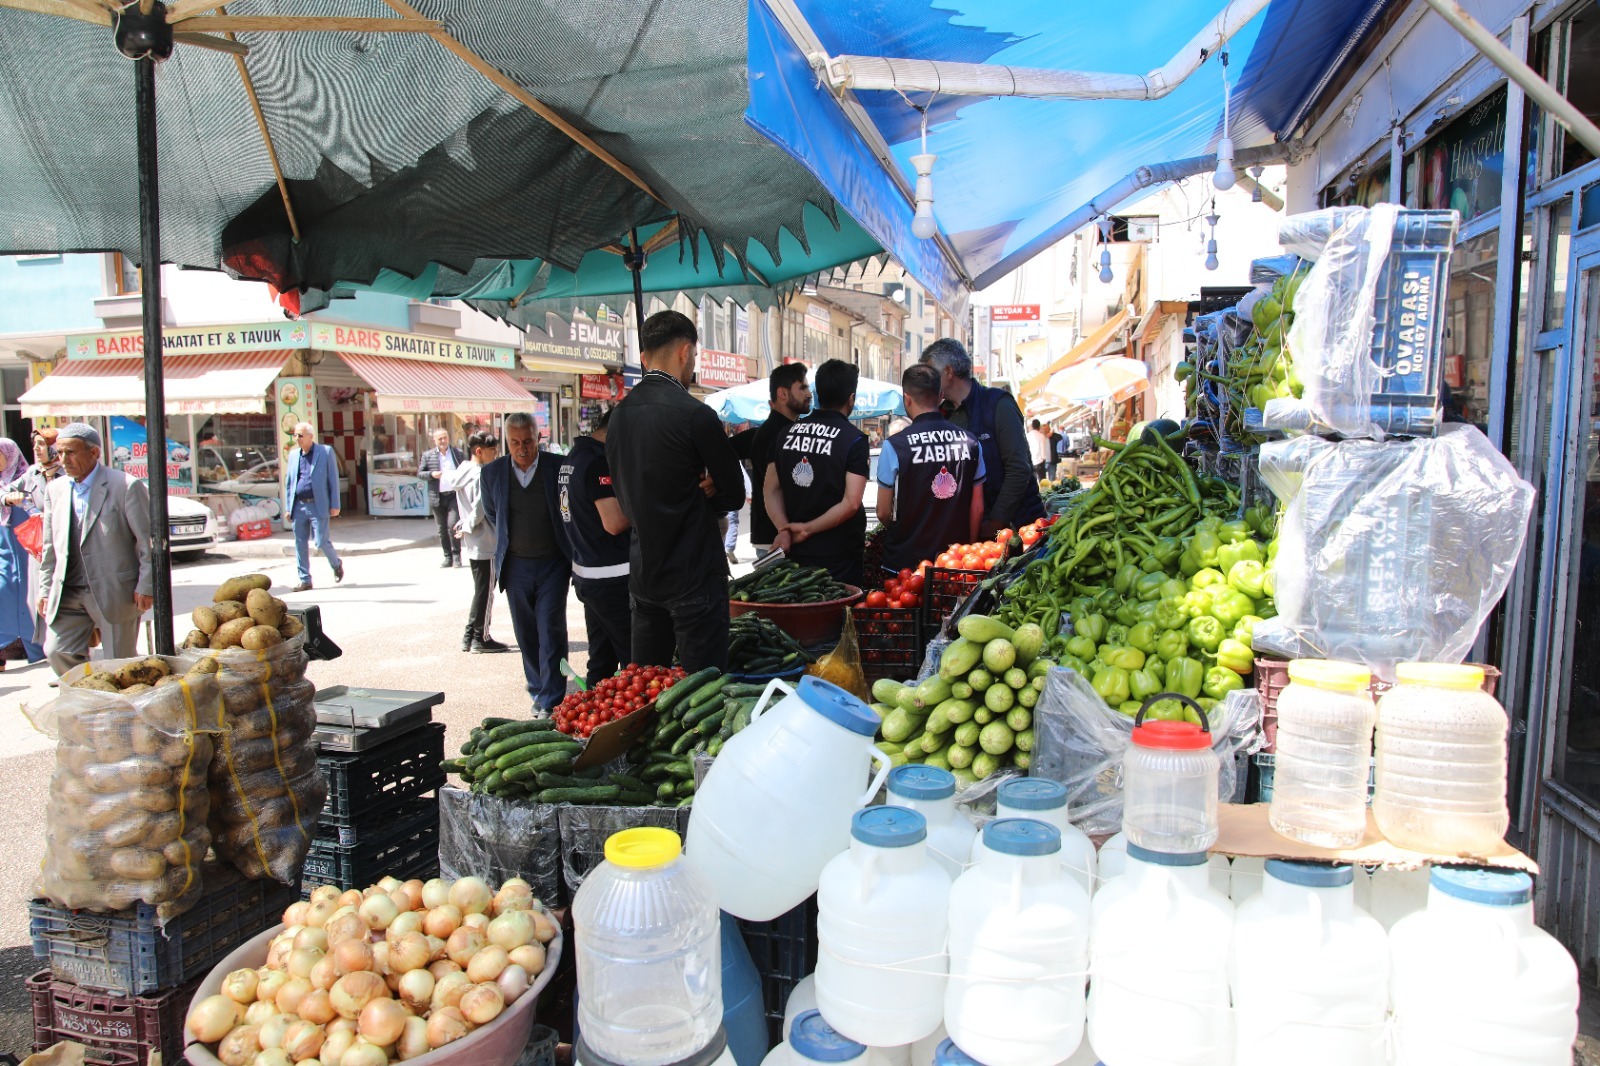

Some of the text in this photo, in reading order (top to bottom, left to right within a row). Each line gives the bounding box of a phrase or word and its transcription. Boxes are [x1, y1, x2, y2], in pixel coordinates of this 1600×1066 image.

[1417, 275, 1431, 320] ADANA
[993, 307, 1022, 315] MEYDAN
[162, 334, 204, 349] AKATAT
[208, 333, 222, 346] ET
[227, 331, 236, 345] &
[240, 329, 282, 344] TAVUK
[335, 327, 381, 352] BARIŞ
[385, 334, 436, 356] SAKATAT
[439, 342, 452, 357] ET
[455, 344, 463, 359] &
[466, 345, 496, 362] TAVUK
[578, 323, 621, 349] EMLAK
[701, 368, 747, 384] TAVUKÇULUK
[783, 435, 833, 456] ZABITA
[910, 443, 971, 464] ZABITA
[1387, 506, 1400, 544] VAN
[62, 960, 98, 975] PAMUK
[101, 965, 122, 978] TC.
[83, 1017, 102, 1025] VAN
